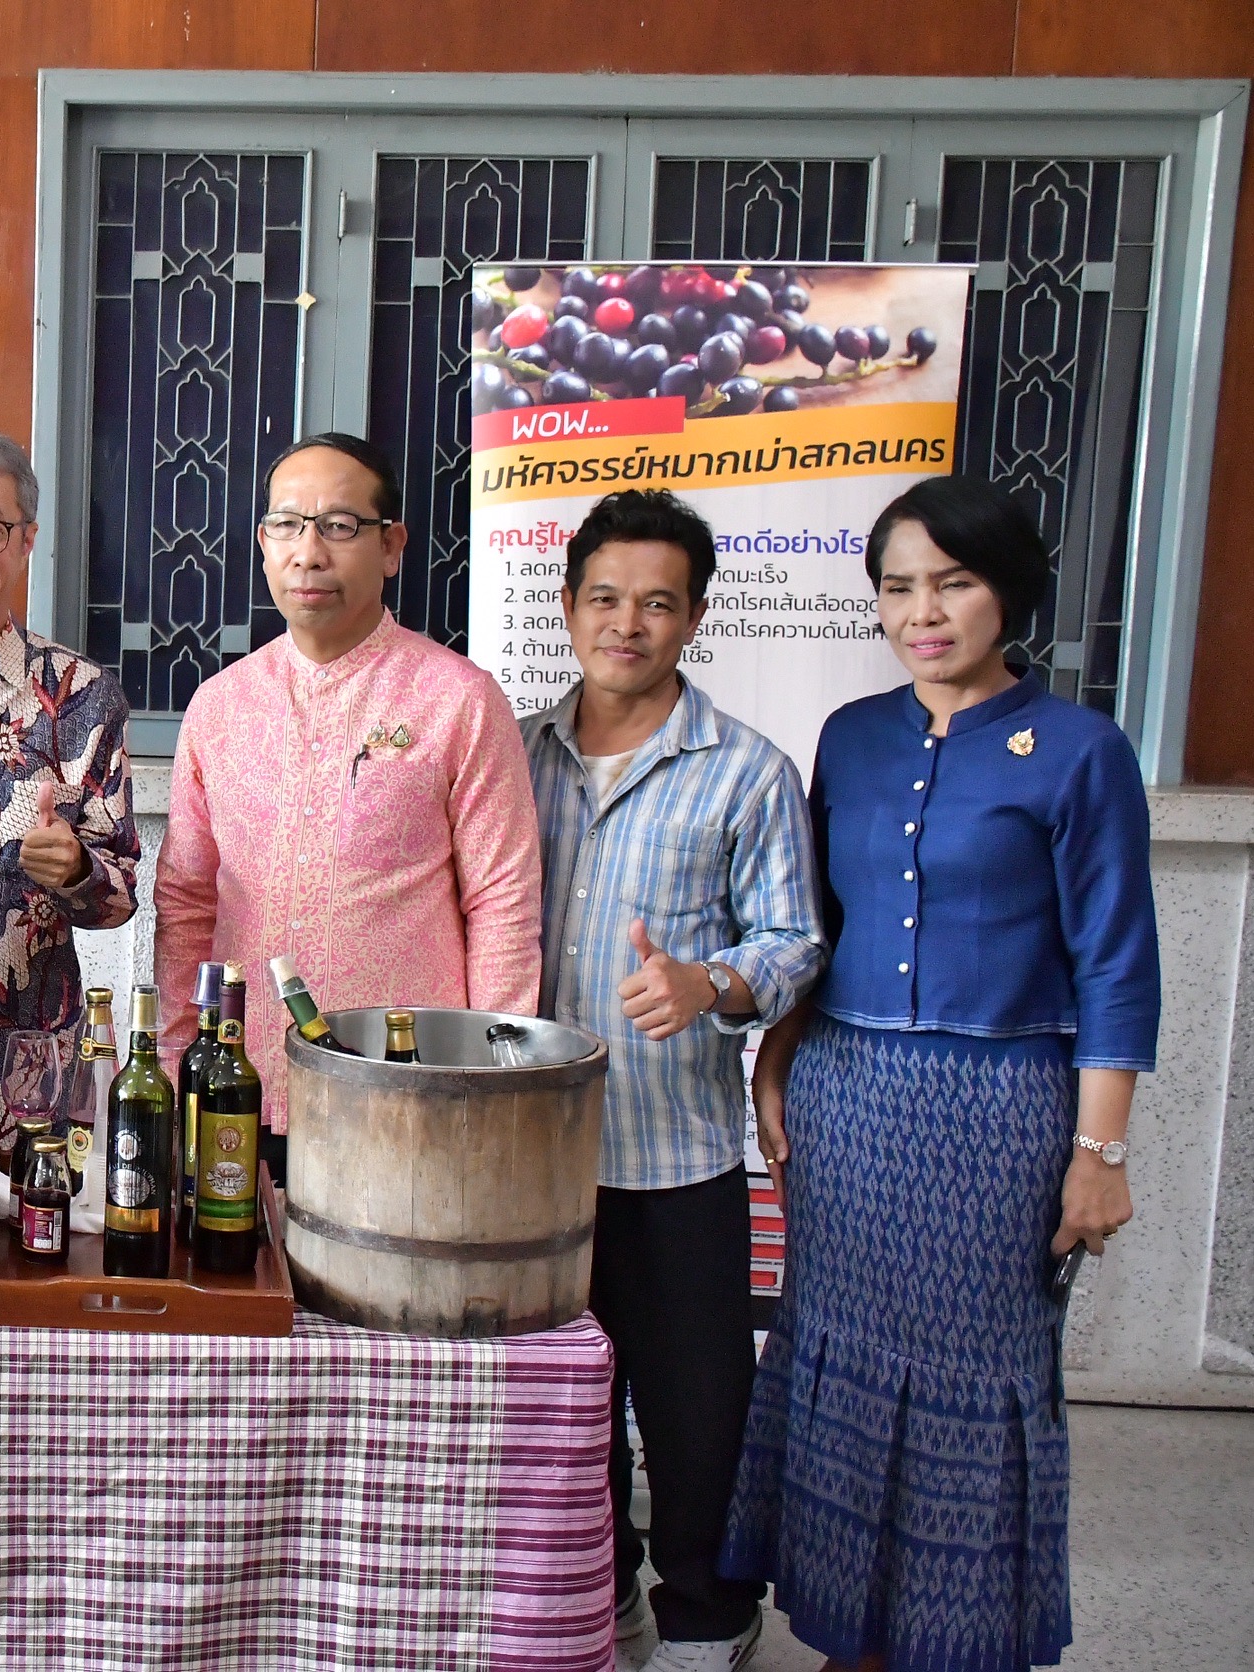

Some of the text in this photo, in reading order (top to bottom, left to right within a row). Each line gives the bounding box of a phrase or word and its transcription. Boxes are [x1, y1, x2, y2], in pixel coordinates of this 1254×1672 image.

[482, 437, 946, 493] มหัศจรรย์หมากเม่าสกลนคร
